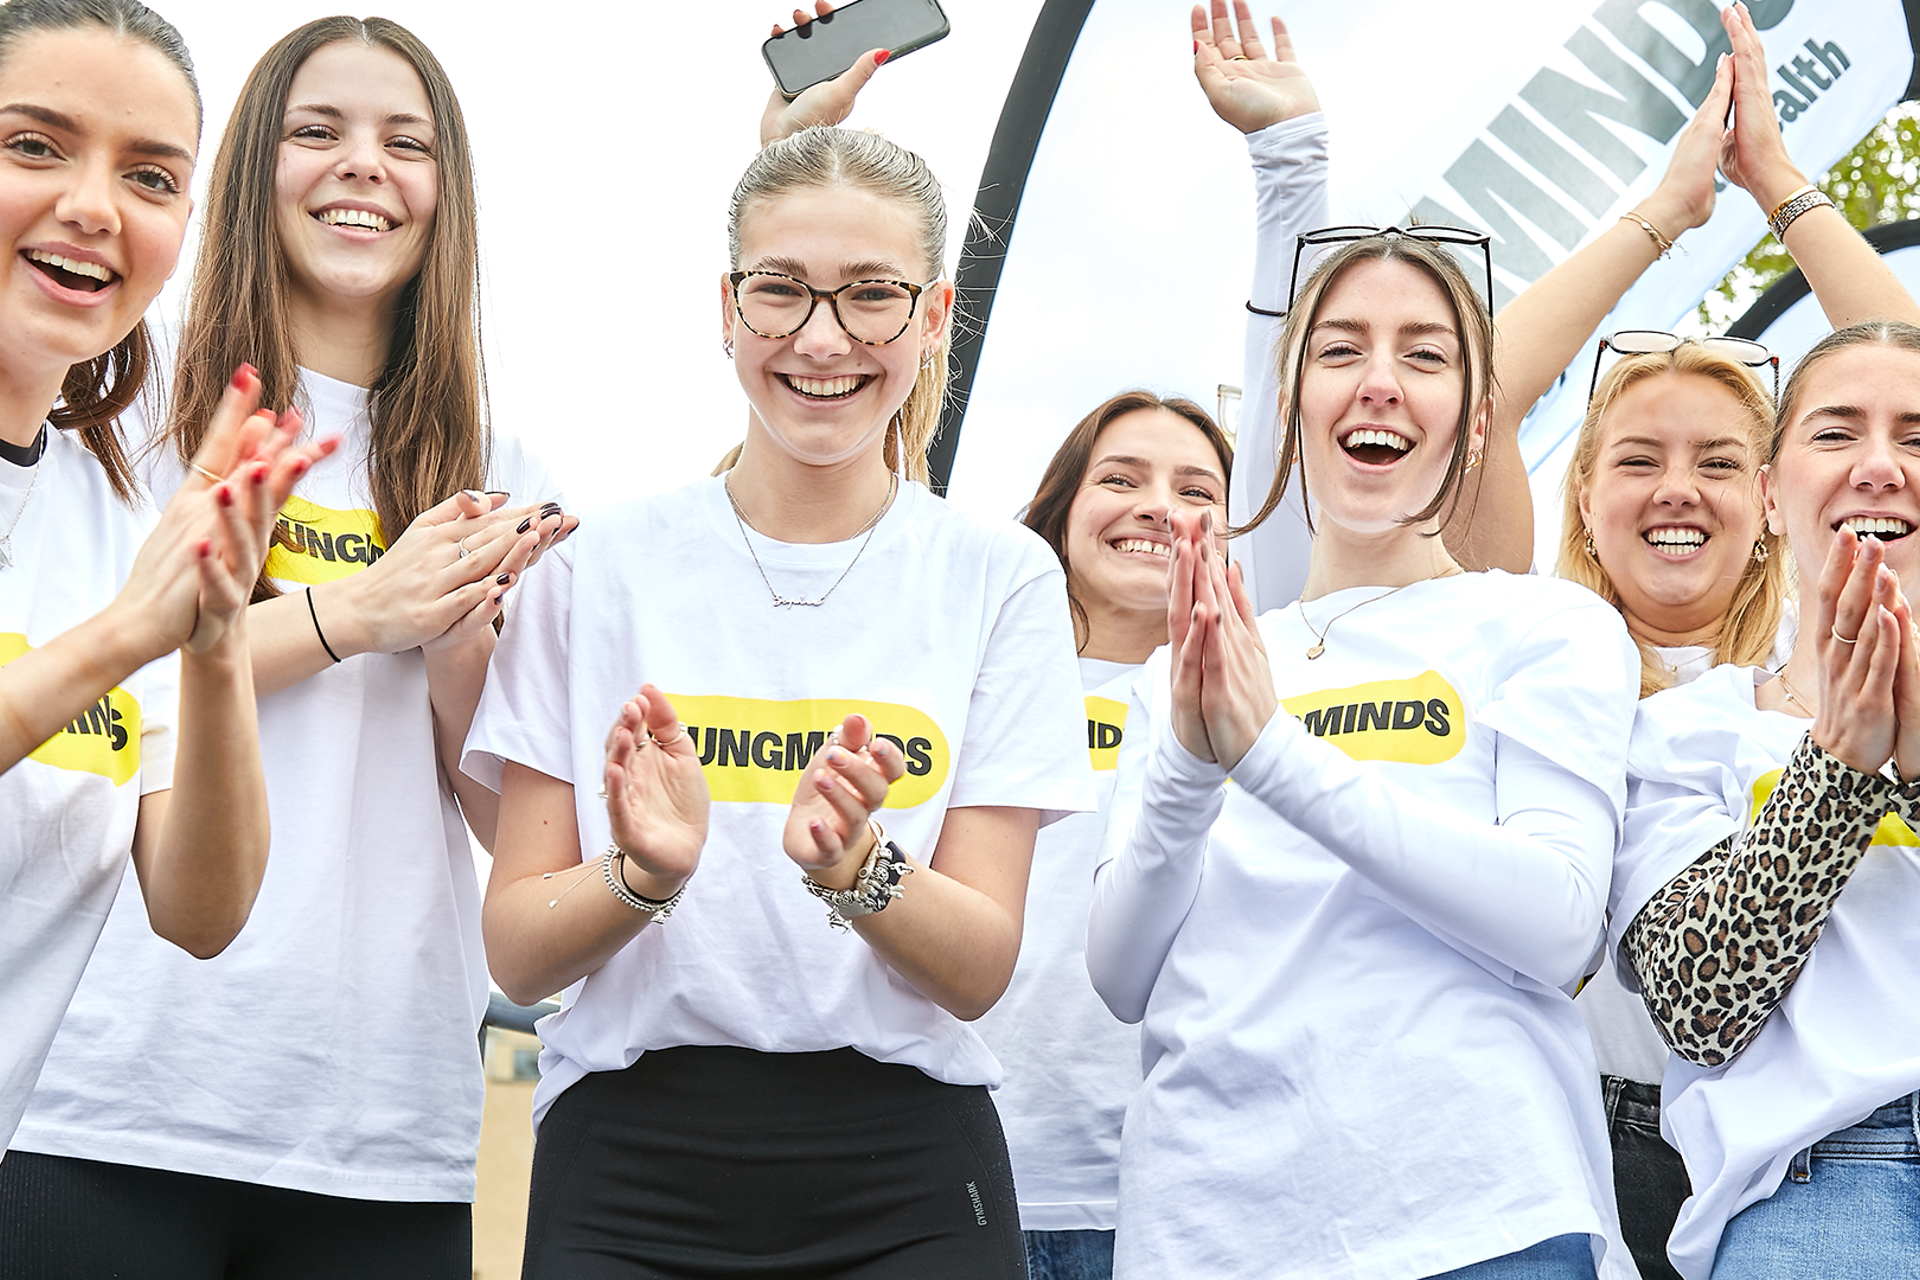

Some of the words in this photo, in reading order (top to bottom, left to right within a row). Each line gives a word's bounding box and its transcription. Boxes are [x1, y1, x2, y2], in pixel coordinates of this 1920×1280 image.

[1773, 37, 1851, 133] alth
[1399, 0, 1796, 313] MIND
[1290, 698, 1451, 737] MINDS
[966, 1180, 988, 1226] GYMSHARK
